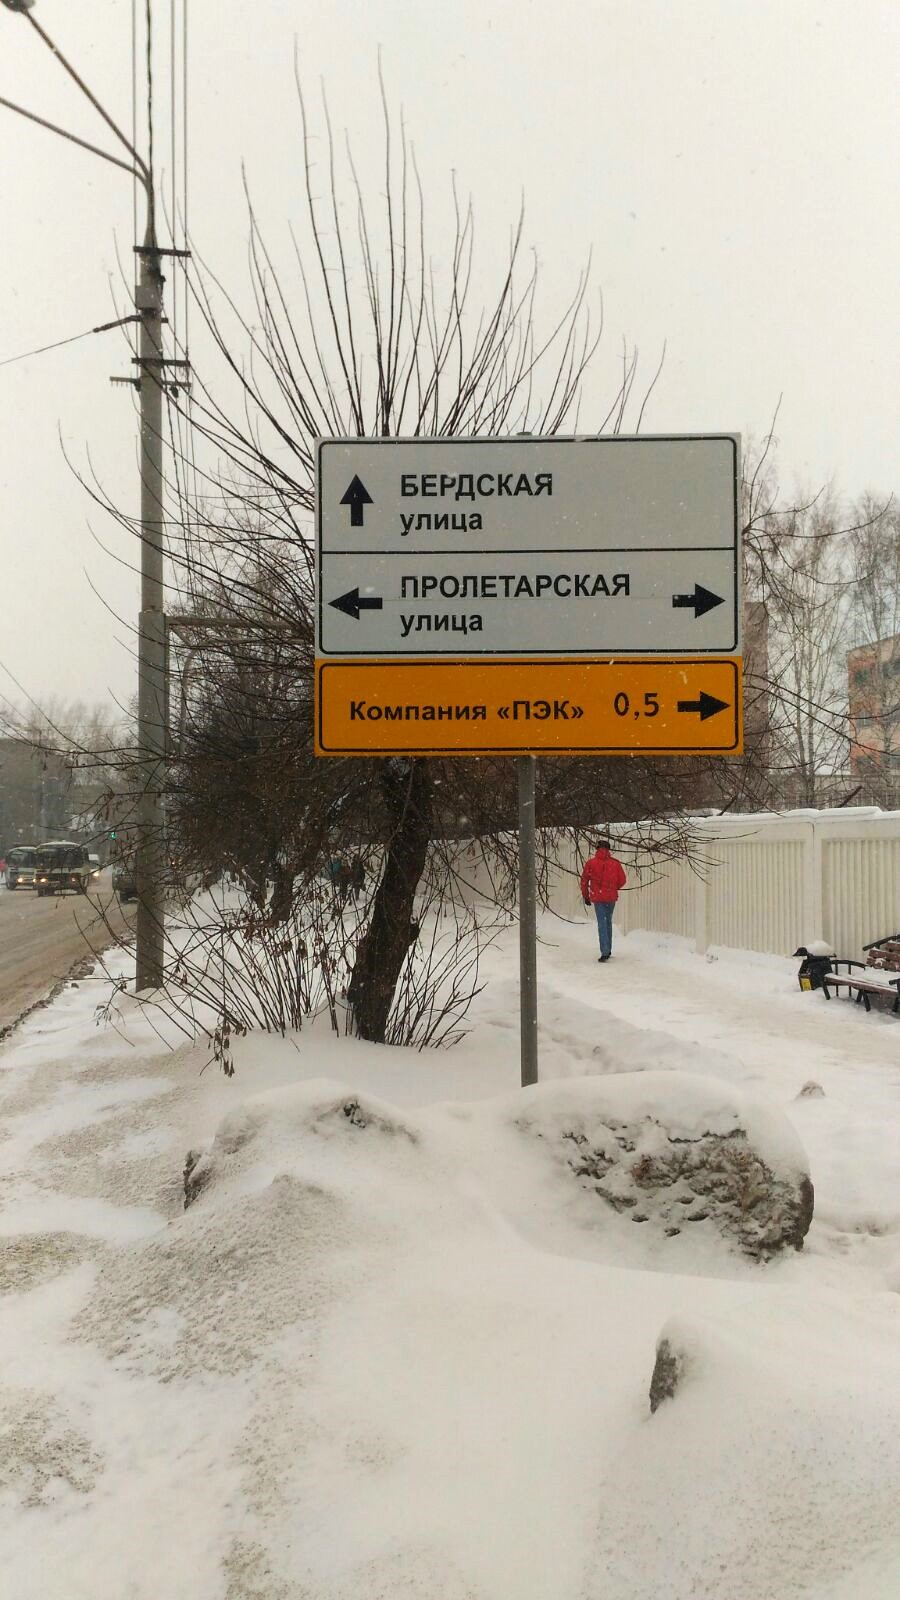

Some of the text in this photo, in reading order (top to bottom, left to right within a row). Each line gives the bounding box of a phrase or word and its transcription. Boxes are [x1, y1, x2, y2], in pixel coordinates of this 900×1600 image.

[400, 473, 553, 500] БЕРДСКАЯ
[400, 512, 483, 536] улица
[400, 573, 631, 599] ПРОЛЕТАРСКАЯ
[400, 613, 483, 637] улица
[349, 692, 660, 721] Компания «ПЭК» 0,5
